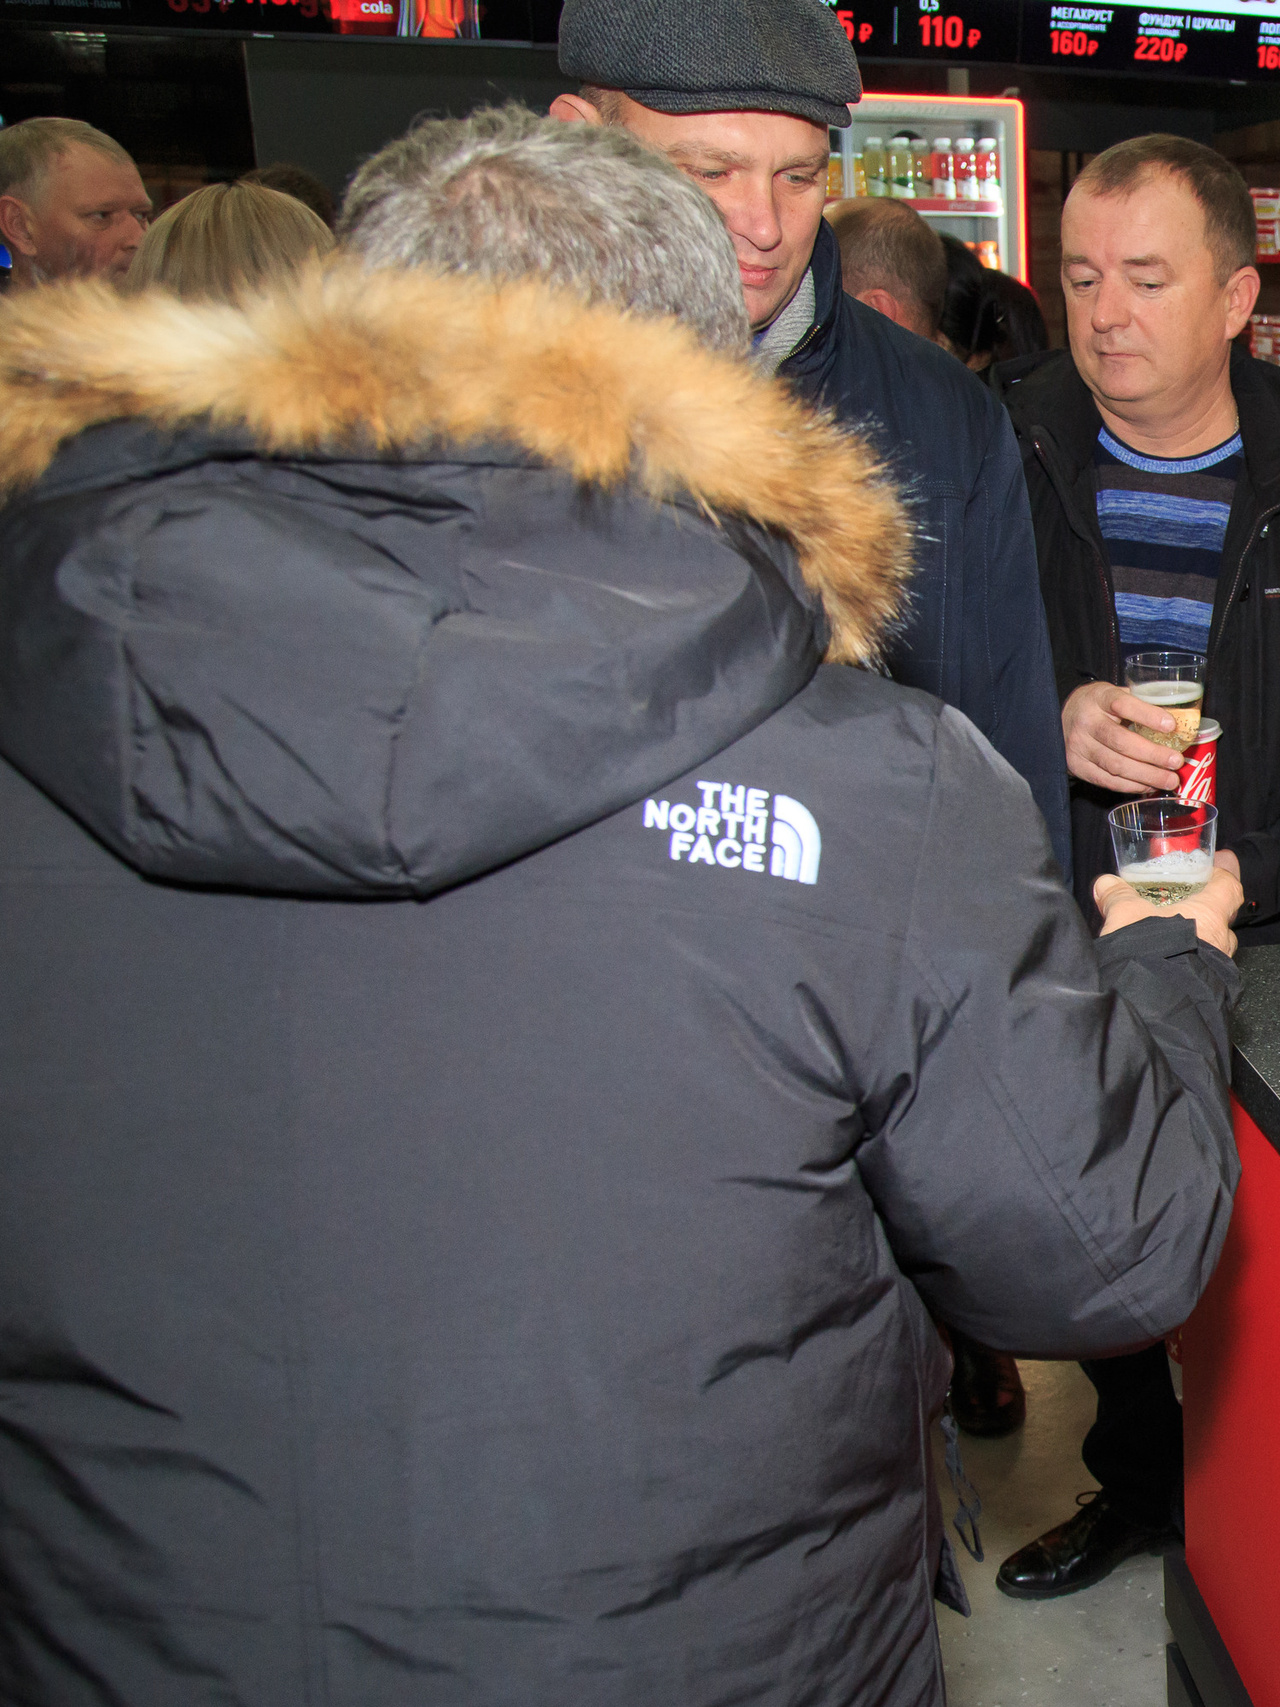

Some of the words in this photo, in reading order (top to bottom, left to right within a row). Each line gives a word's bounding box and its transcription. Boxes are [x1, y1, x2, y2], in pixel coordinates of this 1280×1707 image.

[696, 780, 769, 818] THE
[643, 798, 767, 844] NORTH
[670, 831, 767, 872] FACE
